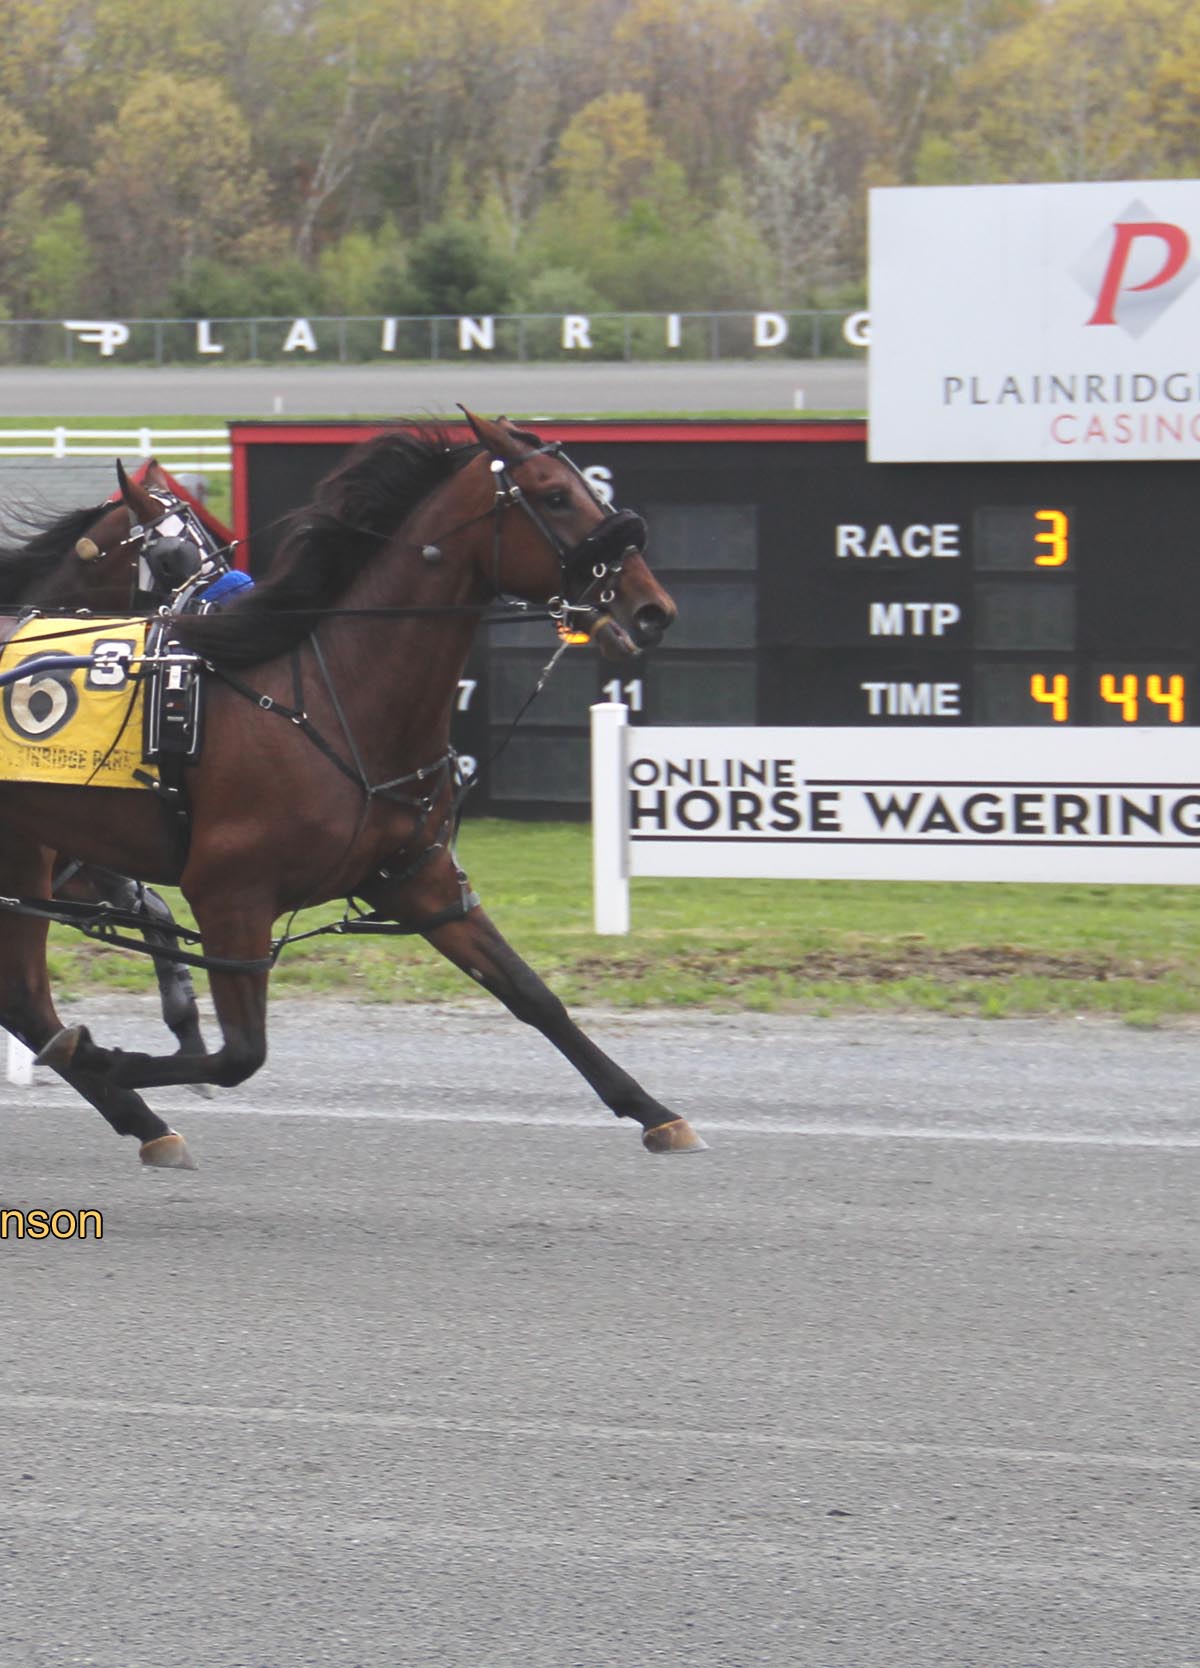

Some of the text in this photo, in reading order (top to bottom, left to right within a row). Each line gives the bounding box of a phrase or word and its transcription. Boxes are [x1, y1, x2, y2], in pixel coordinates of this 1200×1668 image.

[942, 373, 1200, 405] PLAINRIDG
[835, 509, 1069, 567] RACE 3
[868, 602, 961, 636] MTP
[89, 642, 132, 686] 3
[5, 652, 76, 741] 6
[456, 680, 478, 711] 7
[603, 679, 643, 711] 11
[860, 673, 1185, 724] TIME 4 44
[628, 758, 796, 788] ONLINE
[629, 788, 1200, 836] HORSE WAGERING
